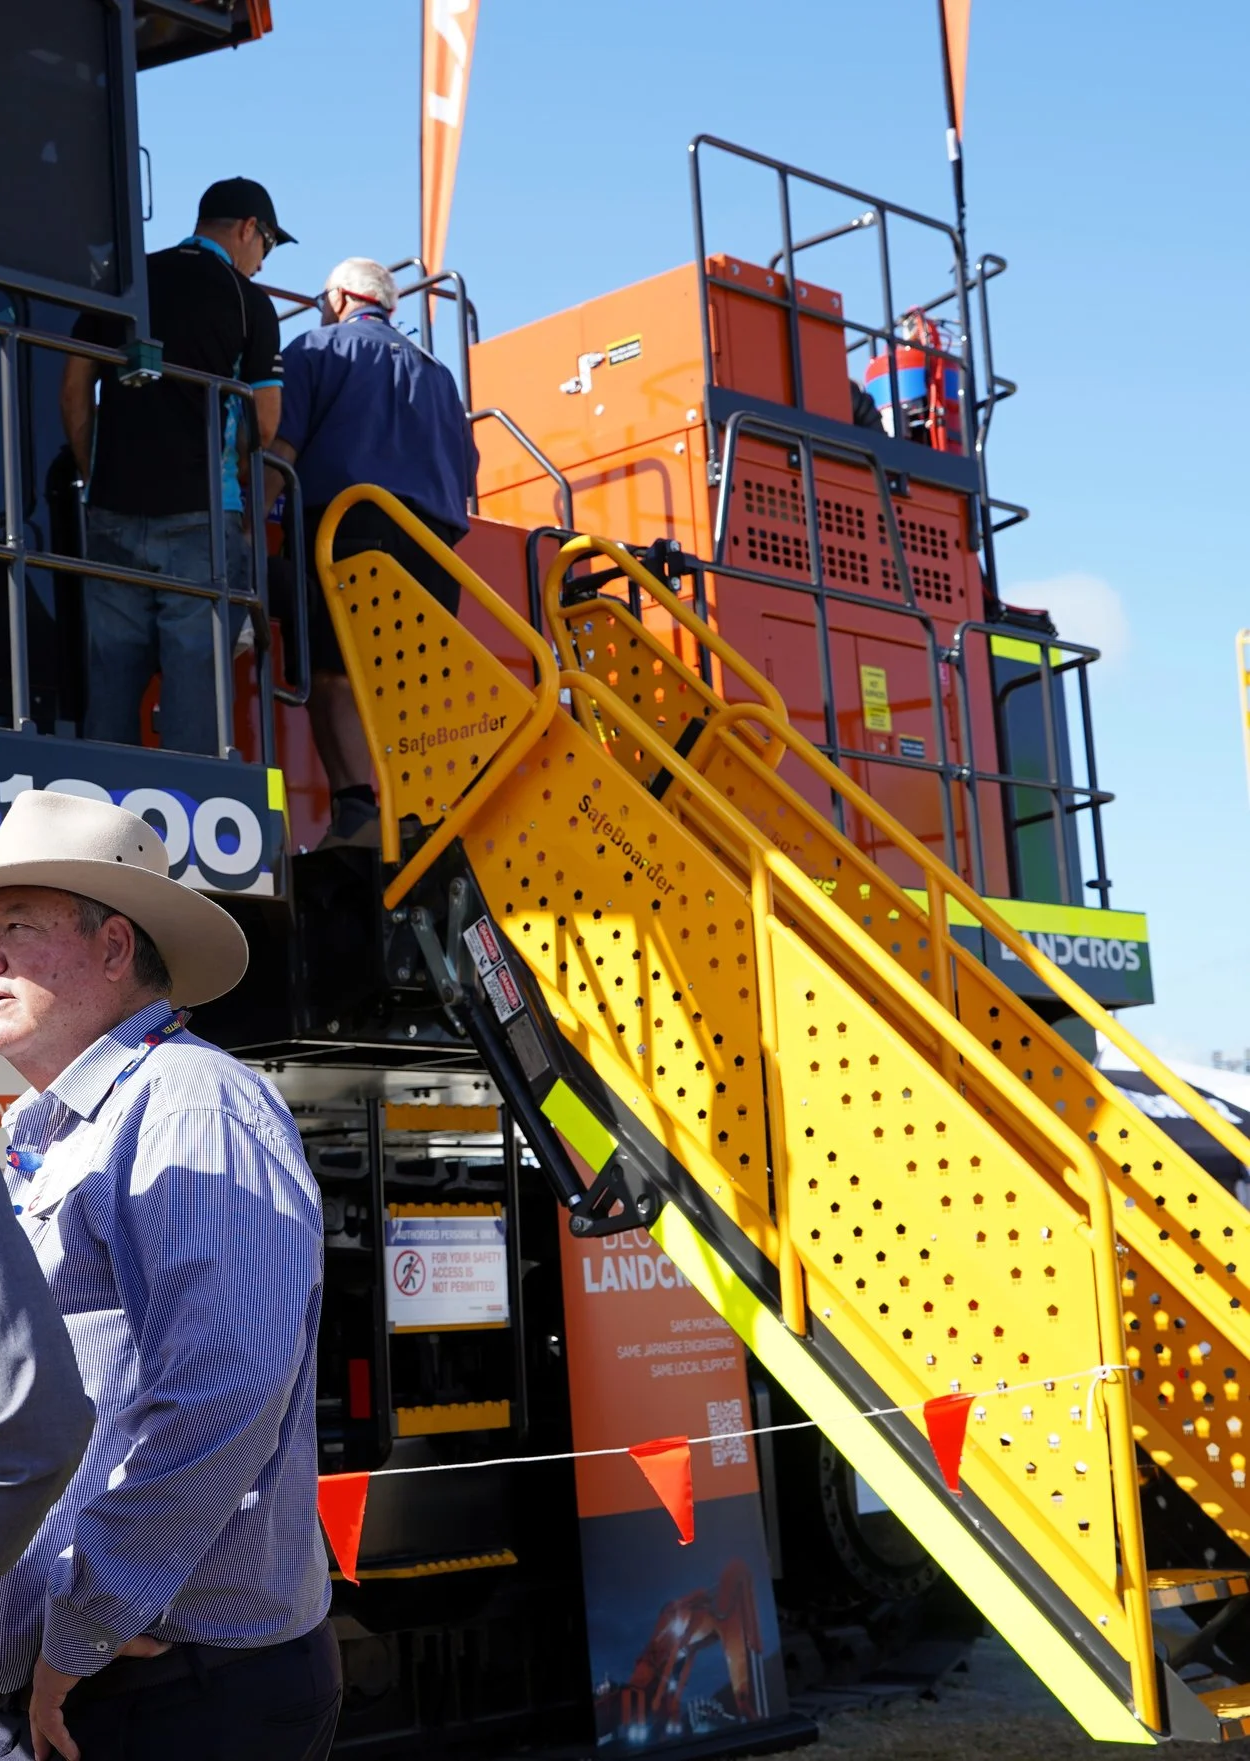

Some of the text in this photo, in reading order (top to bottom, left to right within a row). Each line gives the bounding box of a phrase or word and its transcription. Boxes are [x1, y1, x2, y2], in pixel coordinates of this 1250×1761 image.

[398, 714, 506, 757] SafeBoarder
[578, 794, 674, 896] SafeBoarder
[432, 1251, 501, 1264] FOR YOUR SAFETY
[432, 1267, 474, 1278] ACCESS IS
[432, 1281, 495, 1293] NOT PERMITTED
[670, 1319, 691, 1332] SAME
[617, 1337, 735, 1359] SAME JAPANESE ENGINEERING
[651, 1363, 674, 1378] SAME
[674, 1361, 702, 1375] LOCAL
